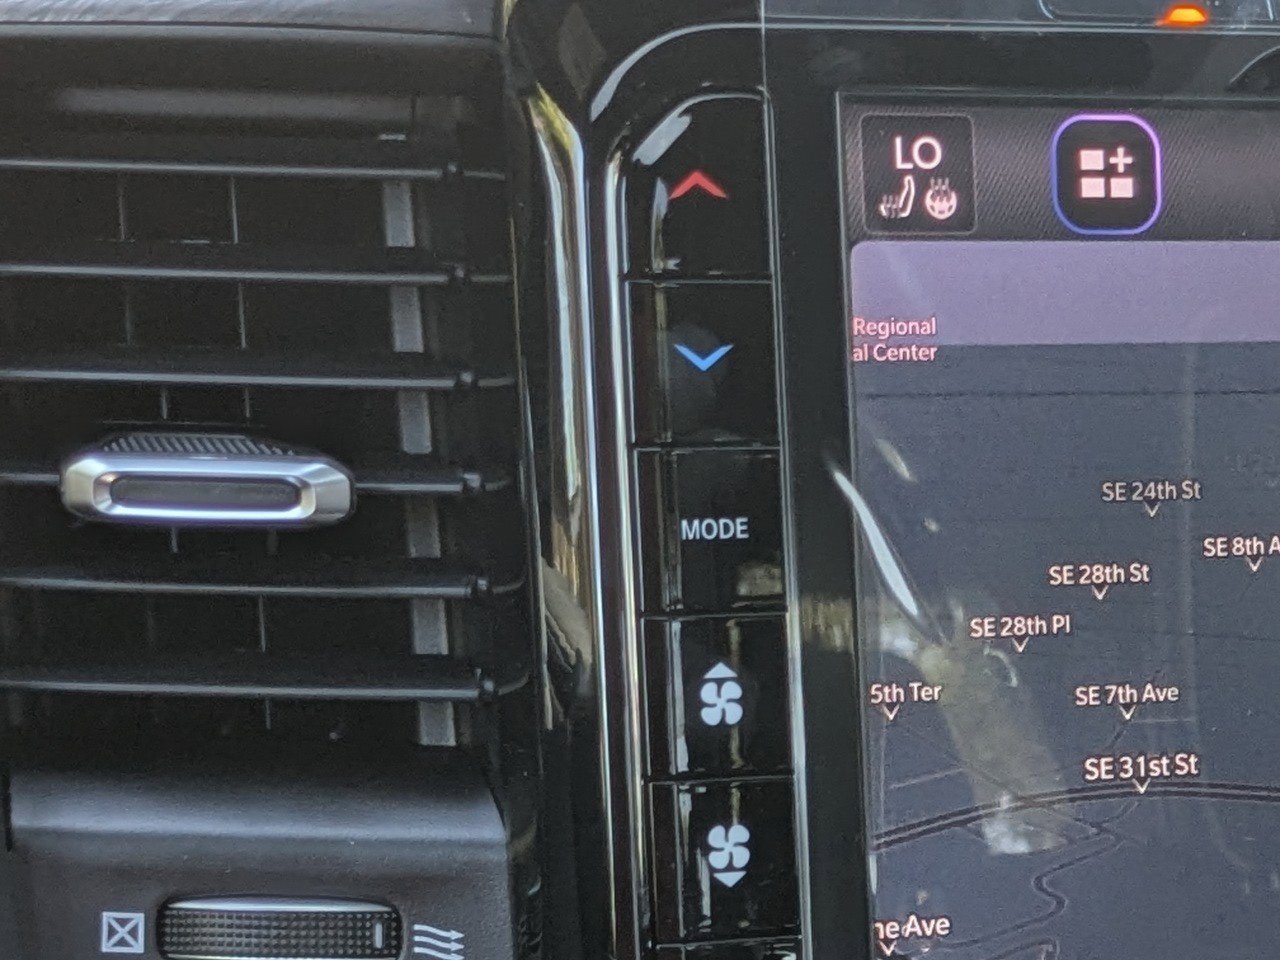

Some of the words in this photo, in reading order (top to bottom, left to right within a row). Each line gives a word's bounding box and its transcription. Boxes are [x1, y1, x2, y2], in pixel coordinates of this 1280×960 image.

[895, 136, 942, 170] LO
[853, 317, 936, 339] Regional
[853, 344, 868, 362] al
[873, 343, 938, 361] Center
[1102, 482, 1126, 501] SE
[1131, 481, 1177, 500] 24th
[1181, 480, 1201, 499] St
[681, 518, 750, 541] MODE
[1204, 537, 1227, 557] SE
[1232, 536, 1264, 556] 8th
[1049, 566, 1073, 585] SE
[1078, 565, 1125, 584] 28th
[1129, 564, 1150, 583] St
[970, 618, 996, 638] SE
[1000, 616, 1047, 636] 28th
[1053, 615, 1070, 634] Pl
[870, 683, 905, 704] 5th
[908, 683, 942, 701] Ter
[1075, 686, 1101, 705] SE
[1106, 684, 1138, 704] 7th
[1143, 684, 1179, 702] Ave
[1084, 759, 1114, 780] SE
[1119, 756, 1169, 778] 31st
[1175, 754, 1198, 776] St
[903, 914, 950, 937] Ave
